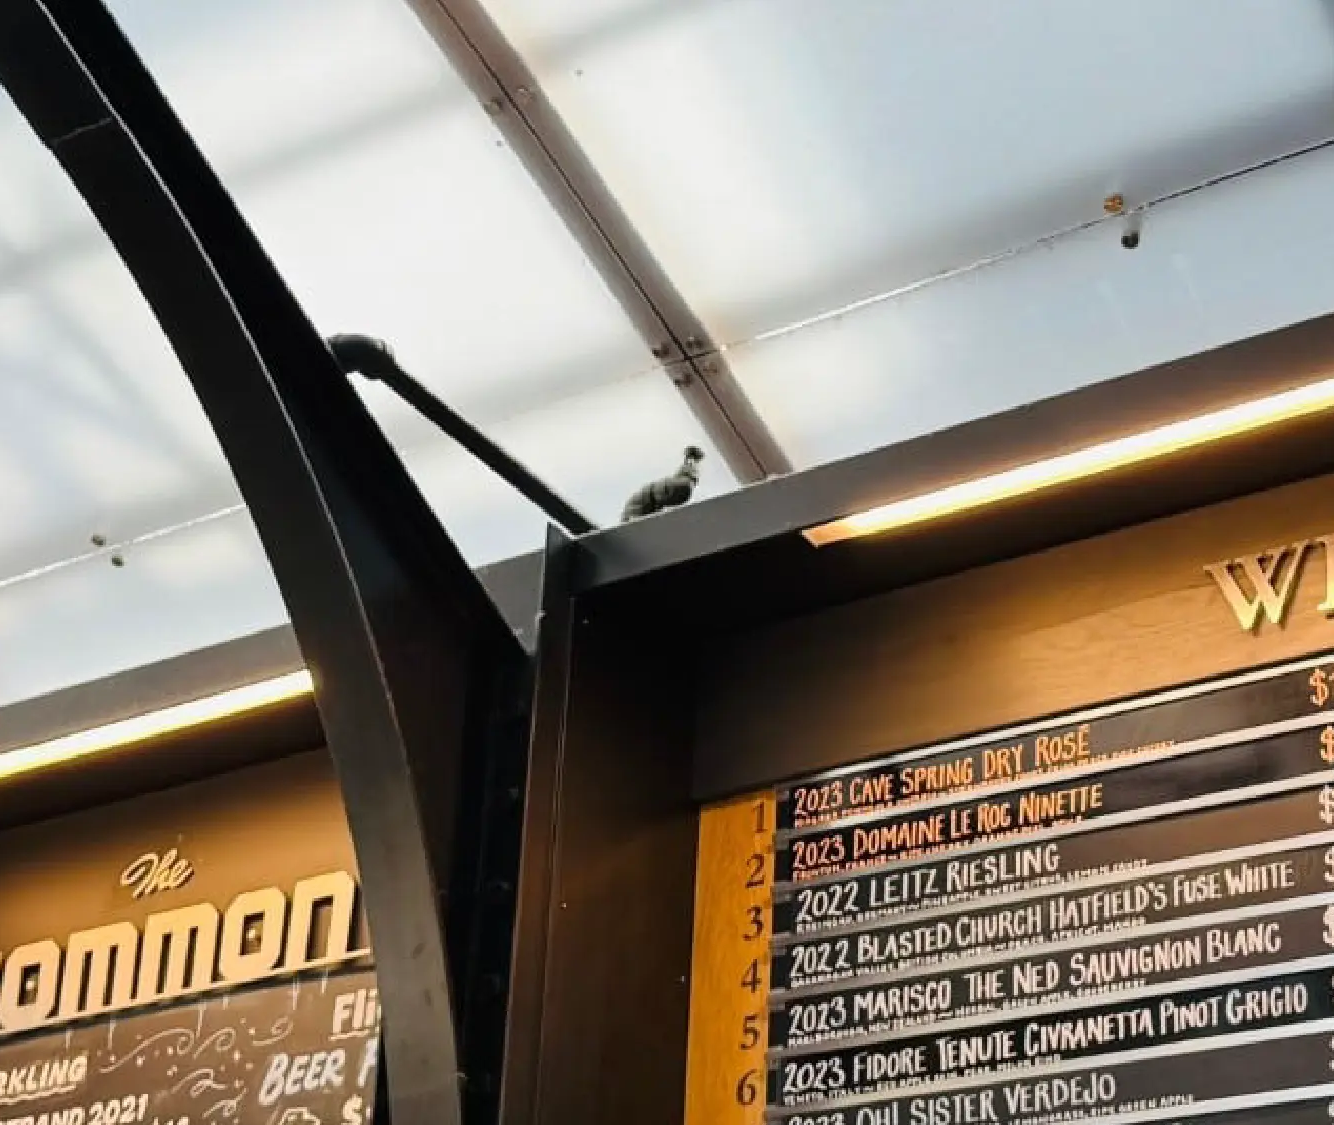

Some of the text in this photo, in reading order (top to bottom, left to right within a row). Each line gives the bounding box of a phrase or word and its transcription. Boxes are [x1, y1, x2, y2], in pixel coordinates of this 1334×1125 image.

[794, 780, 843, 816] 2023
[850, 773, 893, 805] CAVE
[900, 759, 972, 794] SPRING
[982, 745, 1022, 780] DRY
[752, 801, 768, 833] 1
[793, 836, 844, 869] 2023
[853, 815, 945, 857] DOMAINE
[1018, 783, 1103, 825] NINETTE
[745, 854, 766, 888] 2
[797, 881, 859, 922] 2022
[870, 870, 939, 906] LEITZ
[946, 842, 1060, 893] RIESLING
[743, 906, 764, 941] 3
[789, 939, 849, 977] 2022
[857, 922, 952, 963] BLASTED
[955, 904, 1041, 946] CHURCH
[1049, 882, 1167, 929] HATFIELD'S
[1174, 873, 1222, 906] FUSE
[1223, 861, 1295, 896] WHITE
[741, 959, 762, 993] 4
[789, 997, 846, 1037] 2023
[853, 980, 951, 1019] MARISCO
[962, 969, 1004, 1002] THE
[1013, 960, 1059, 993] NED
[1068, 936, 1200, 985] SAUVIGNON
[1207, 922, 1282, 963] BLANC
[740, 1015, 761, 1050] 5
[784, 1057, 846, 1094] 2023
[853, 1046, 927, 1080] FIDORE
[936, 1030, 1016, 1070] TENUTE
[1160, 997, 1220, 1035] PINOT
[1226, 983, 1308, 1026] GRIGIO
[259, 1049, 346, 1106] BEER
[736, 1069, 757, 1106] 6
[1004, 1073, 1116, 1114] VERDEJO
